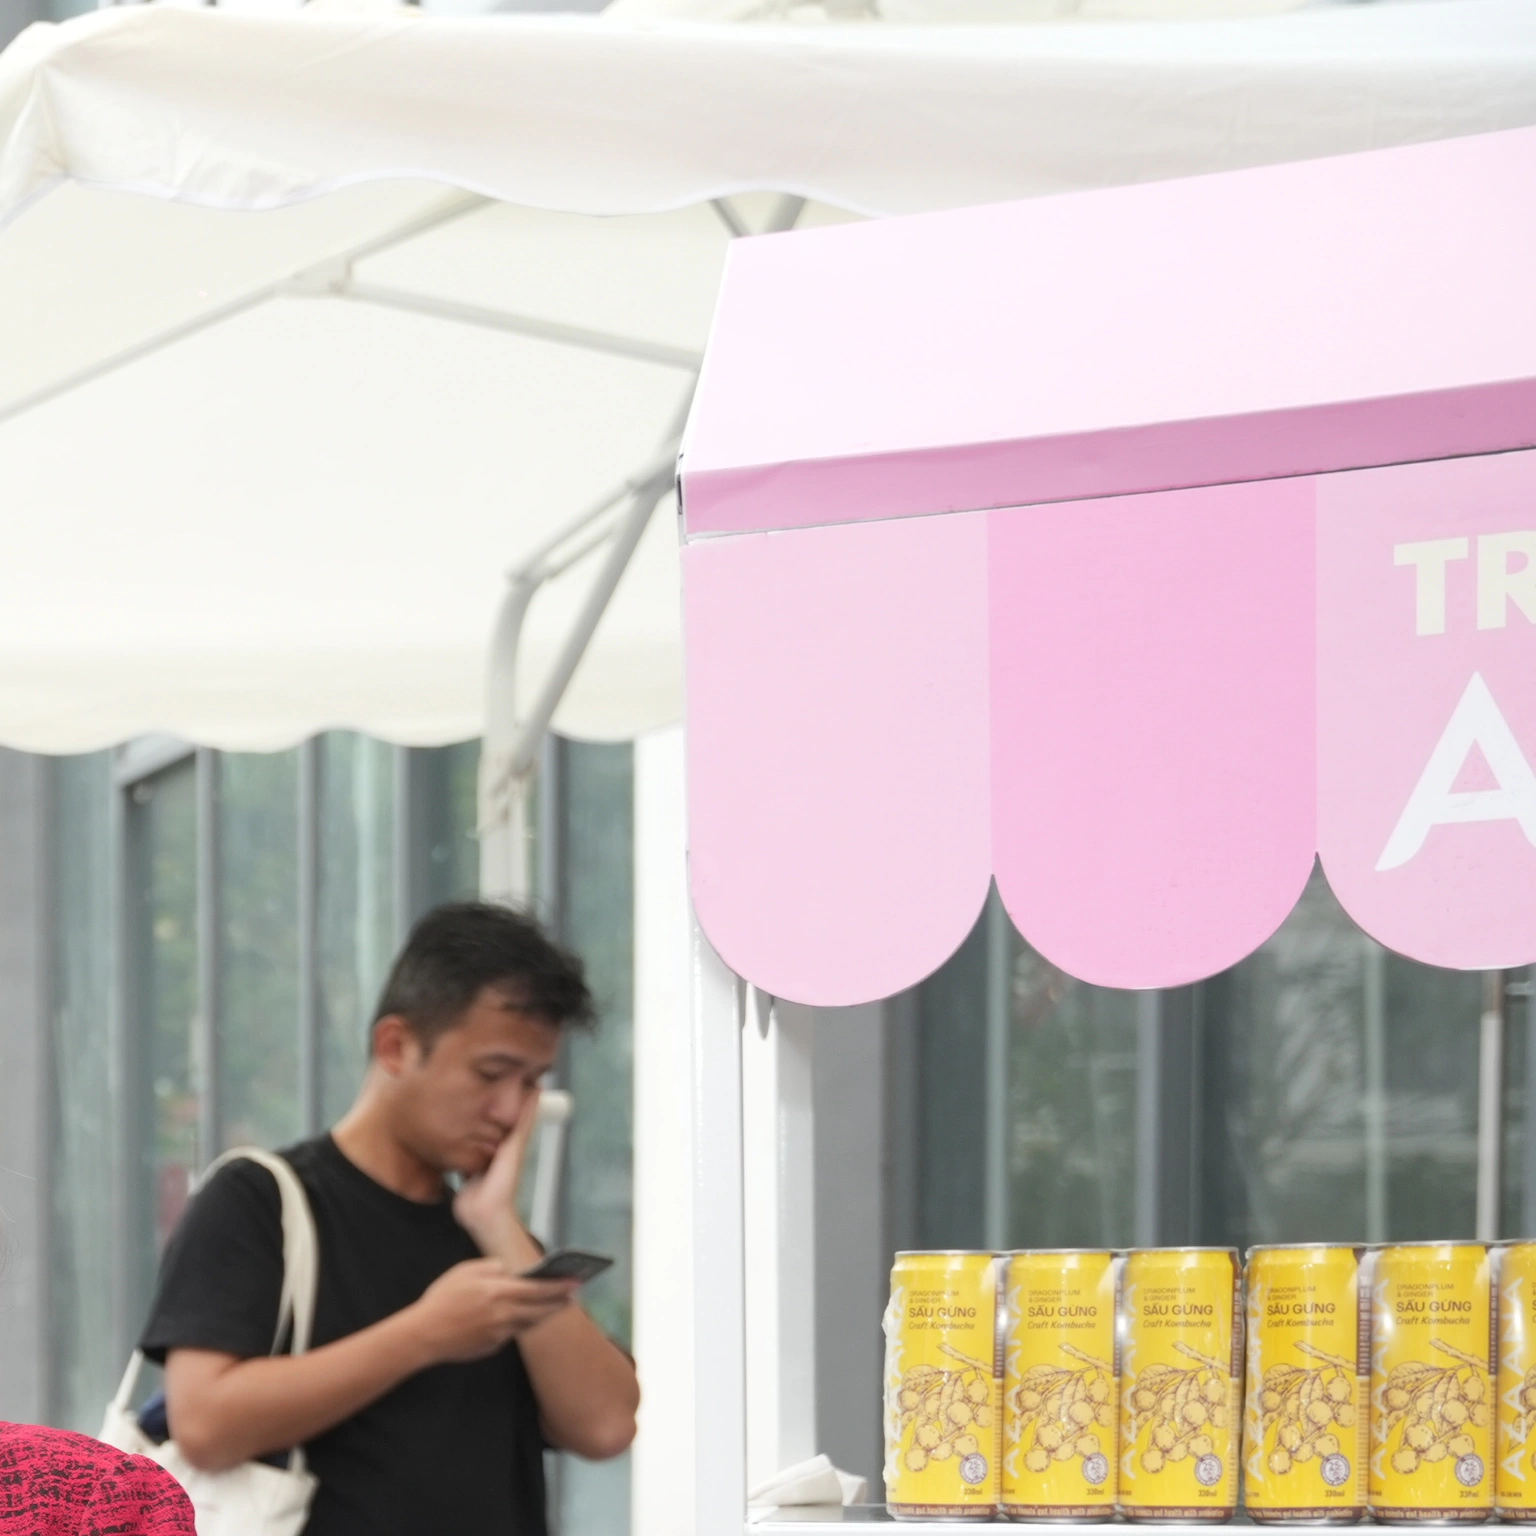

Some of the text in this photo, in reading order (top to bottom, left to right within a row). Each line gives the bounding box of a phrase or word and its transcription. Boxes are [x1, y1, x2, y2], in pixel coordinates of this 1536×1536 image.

[1028, 1320, 1096, 1329] Craft Kombucha
[1143, 1319, 1212, 1328] Craft Kombucha
[1267, 1317, 1334, 1329] Craft Kombucha
[1396, 1315, 1470, 1325] Craft Kombucha
[909, 1321, 975, 1330] Craft Kombucha
